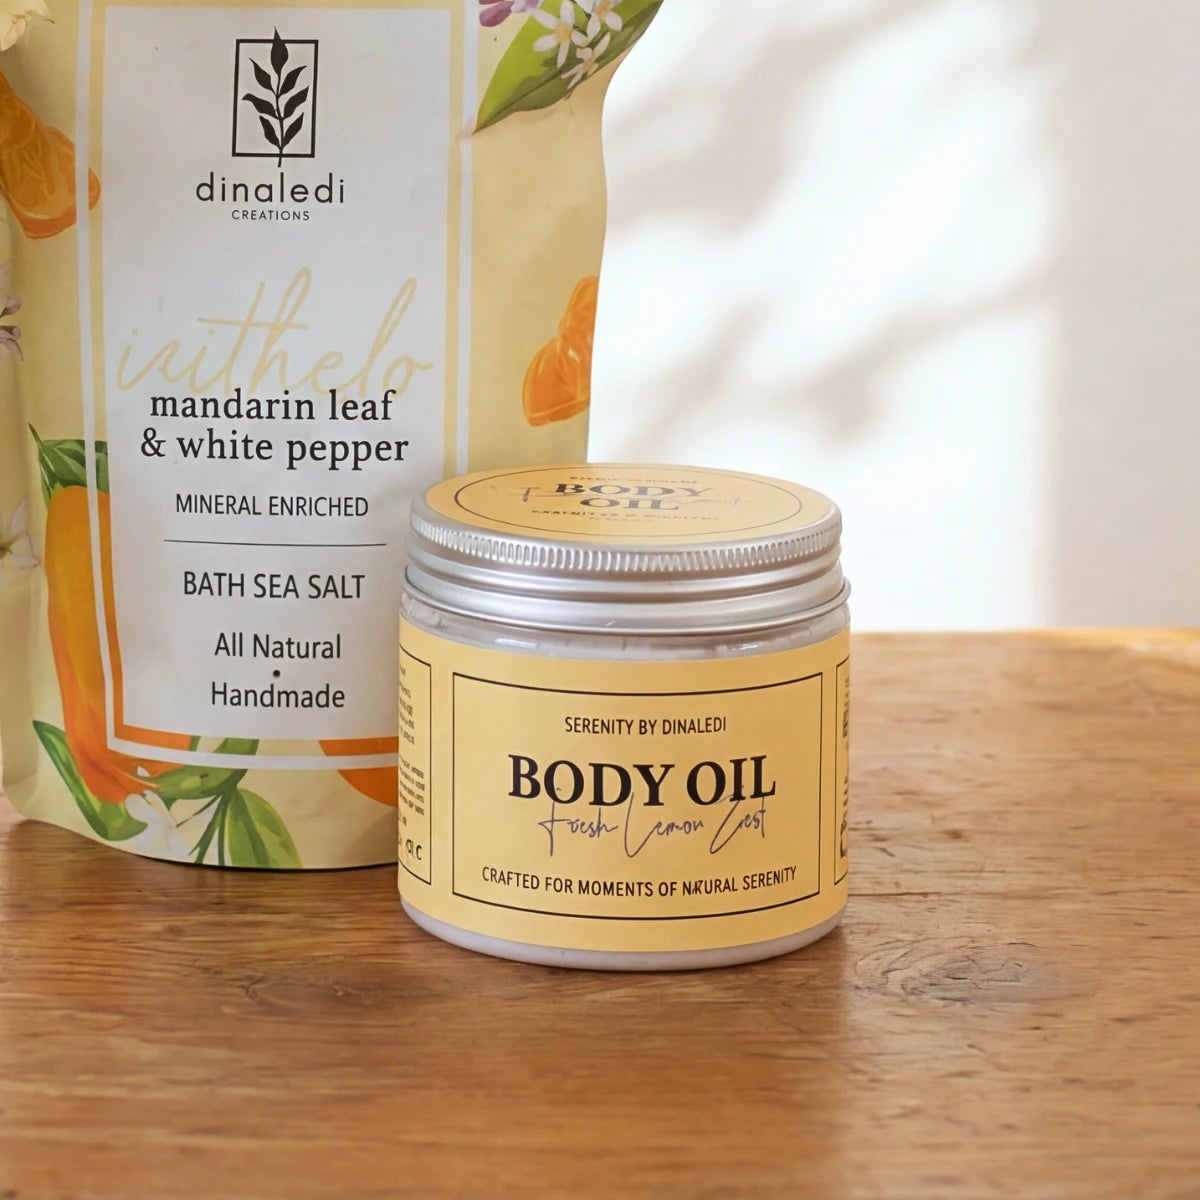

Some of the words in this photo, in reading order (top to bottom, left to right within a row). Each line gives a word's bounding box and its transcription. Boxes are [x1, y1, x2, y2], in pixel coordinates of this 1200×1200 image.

[195, 171, 345, 204] dinaledi
[231, 209, 311, 221] CREATIONS
[149, 387, 316, 420] mandarin
[328, 388, 397, 421] leaf
[140, 427, 166, 458] &
[176, 427, 273, 460] white
[286, 439, 410, 471] pepper
[555, 482, 712, 497] BODY
[579, 497, 680, 511] OIL
[176, 493, 262, 516] MINERAL
[268, 495, 369, 517] ENRICHED
[183, 570, 245, 598] BATH
[253, 573, 300, 599] SEA
[308, 574, 366, 600] SALT
[214, 631, 243, 658] All
[253, 633, 341, 660] Natural
[211, 681, 346, 709] Handmade
[564, 716, 634, 736] SERENITY
[639, 719, 658, 736] BY
[662, 716, 727, 736] DINALEDI
[508, 754, 675, 806] BODY
[686, 754, 777, 806] OIL
[538, 798, 620, 857] Fresh
[482, 866, 541, 891] CRAFTED
[545, 876, 574, 895] FOR
[577, 879, 655, 898] MOMENTS
[658, 880, 678, 897] OF
[742, 865, 798, 891] SERENITY
